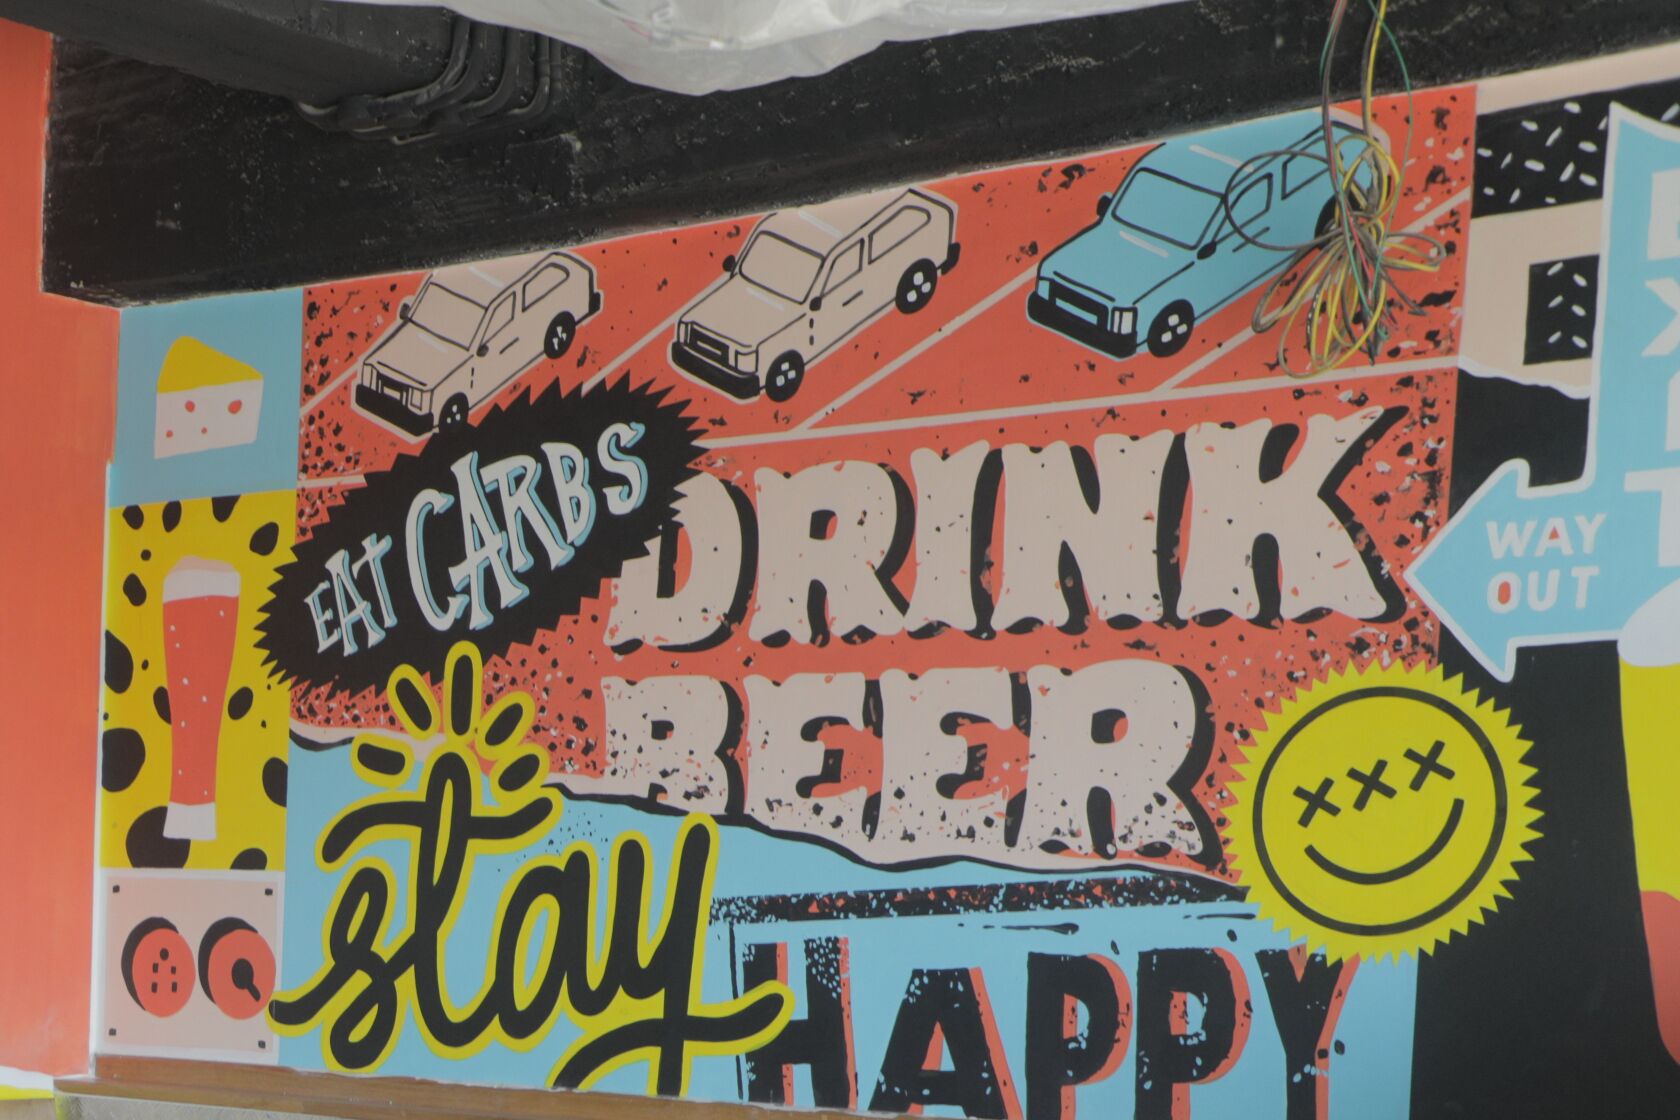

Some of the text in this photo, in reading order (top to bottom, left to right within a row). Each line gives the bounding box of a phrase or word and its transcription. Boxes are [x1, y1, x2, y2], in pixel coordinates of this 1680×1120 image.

[303, 421, 649, 657] EAT CARBS
[602, 406, 1409, 653] DRINK
[1485, 513, 1607, 560] WAY
[1486, 566, 1600, 613] OUT
[600, 658, 1221, 866] BEER
[267, 746, 794, 1097] stay
